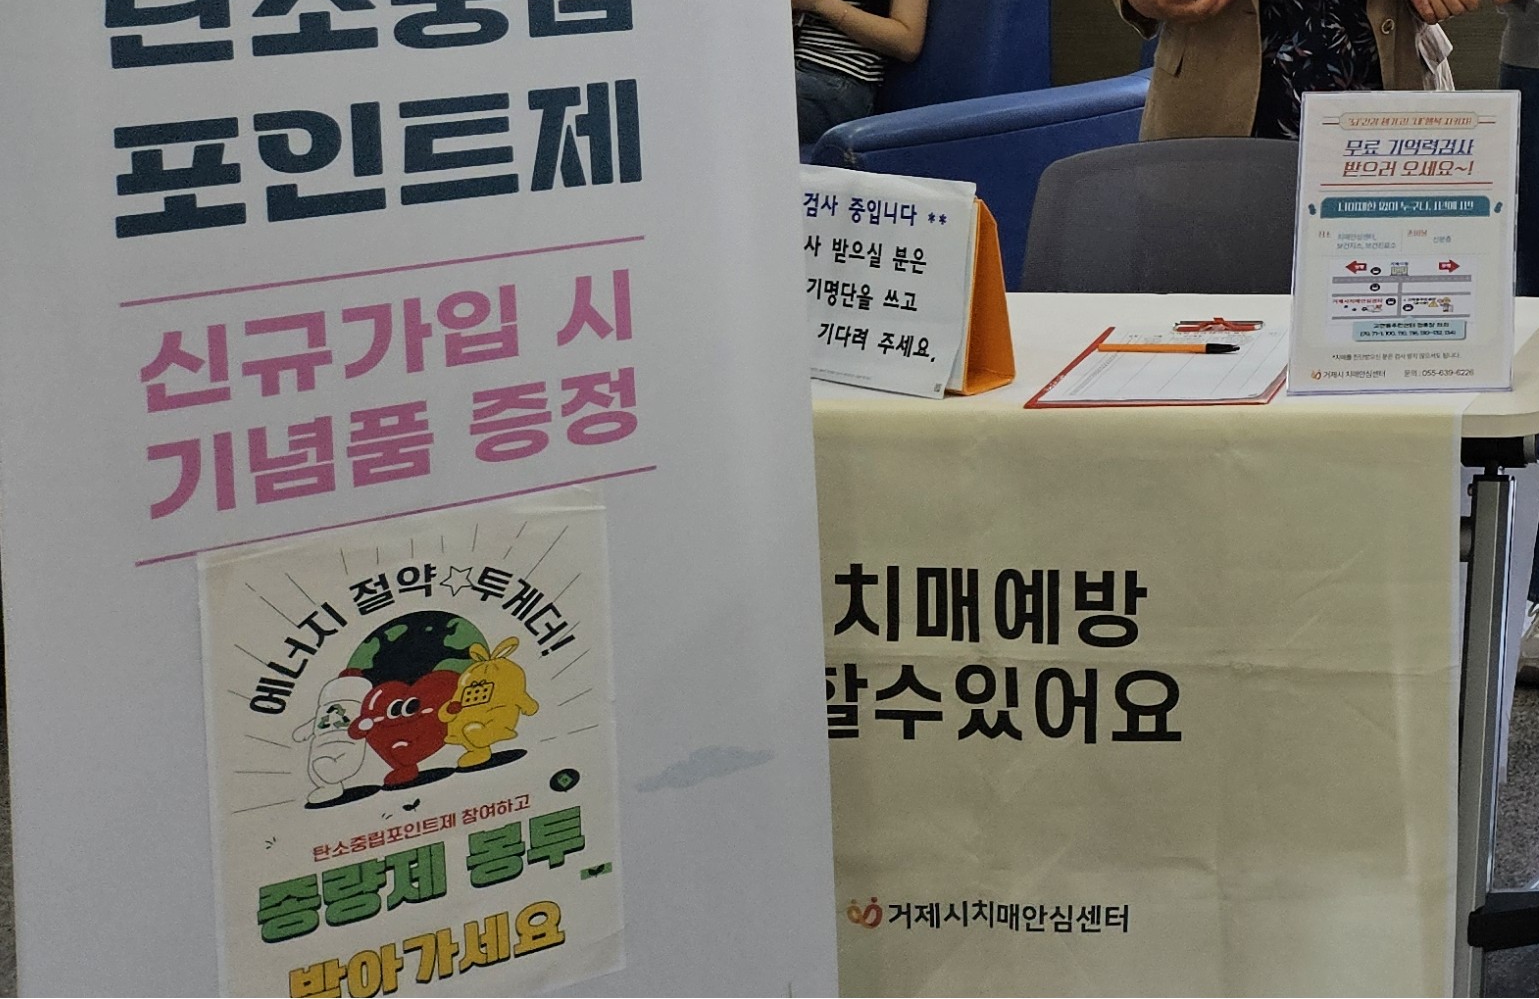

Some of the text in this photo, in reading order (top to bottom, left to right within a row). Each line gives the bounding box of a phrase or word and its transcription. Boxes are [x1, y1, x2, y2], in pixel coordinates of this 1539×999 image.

[114, 79, 642, 239] 포인트제
[1343, 160, 1397, 177] 받으러
[1345, 139, 1381, 155] 무료
[803, 192, 918, 226] 검사 중입니다
[803, 235, 927, 274] 사 받으실 분은
[806, 278, 917, 312] 기명단을 쓰고
[139, 269, 634, 413] 신규가입 시
[817, 323, 869, 350] 기다려
[147, 366, 639, 520] 기념품 증정
[834, 563, 1148, 648] 치매예방
[249, 602, 349, 716] 에너지
[312, 793, 531, 862] 탄소중립포인트제 참여하고
[466, 805, 586, 890] 봉투
[288, 900, 566, 998] 받아가세요
[888, 900, 1130, 933] 거제시치매안심센터
